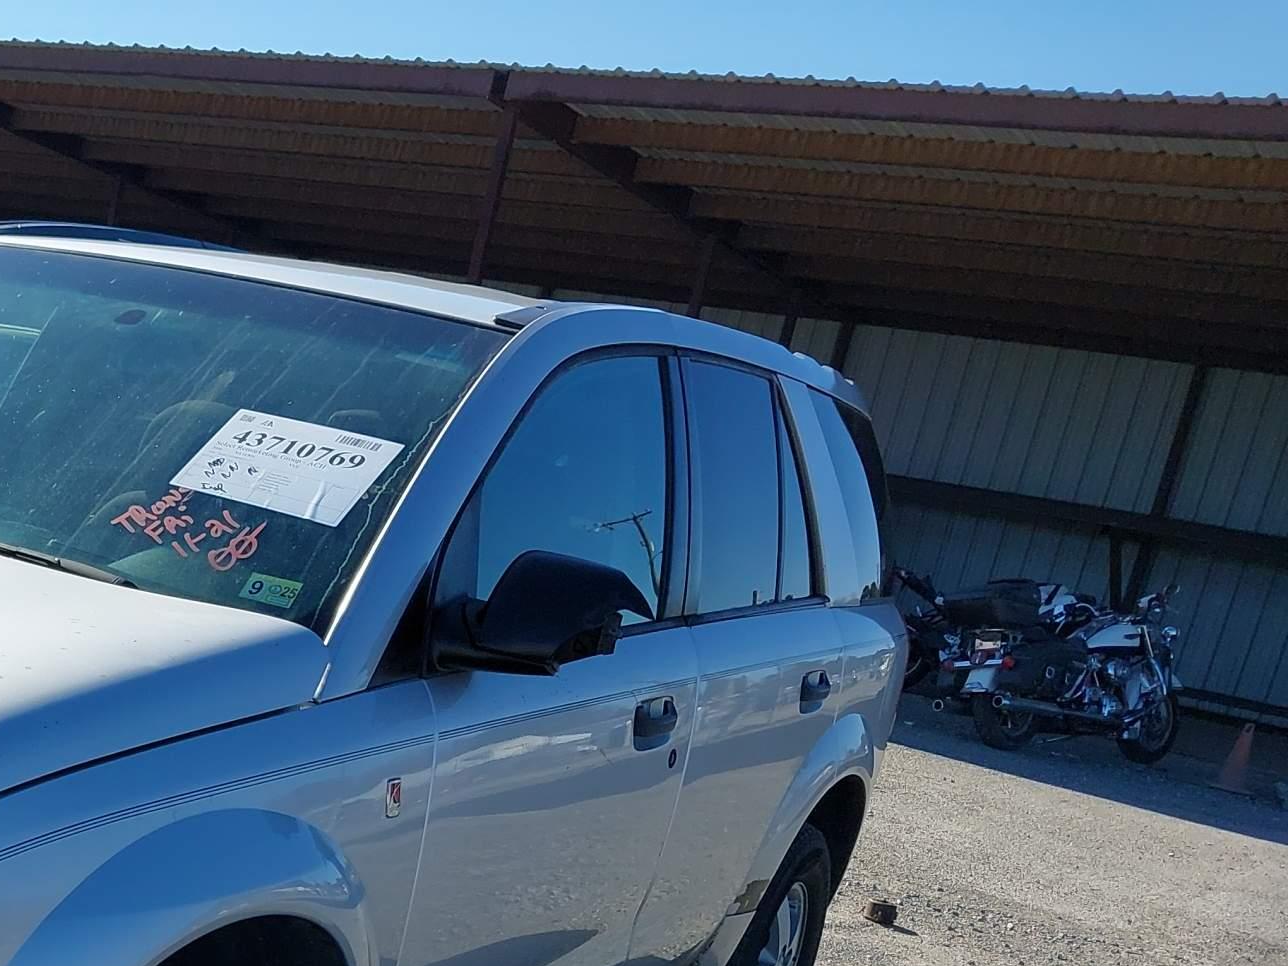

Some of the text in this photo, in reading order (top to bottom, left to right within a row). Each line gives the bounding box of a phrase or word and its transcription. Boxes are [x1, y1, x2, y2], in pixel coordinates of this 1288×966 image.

[232, 430, 366, 470] 43710769
[248, 580, 299, 599] 9 25
